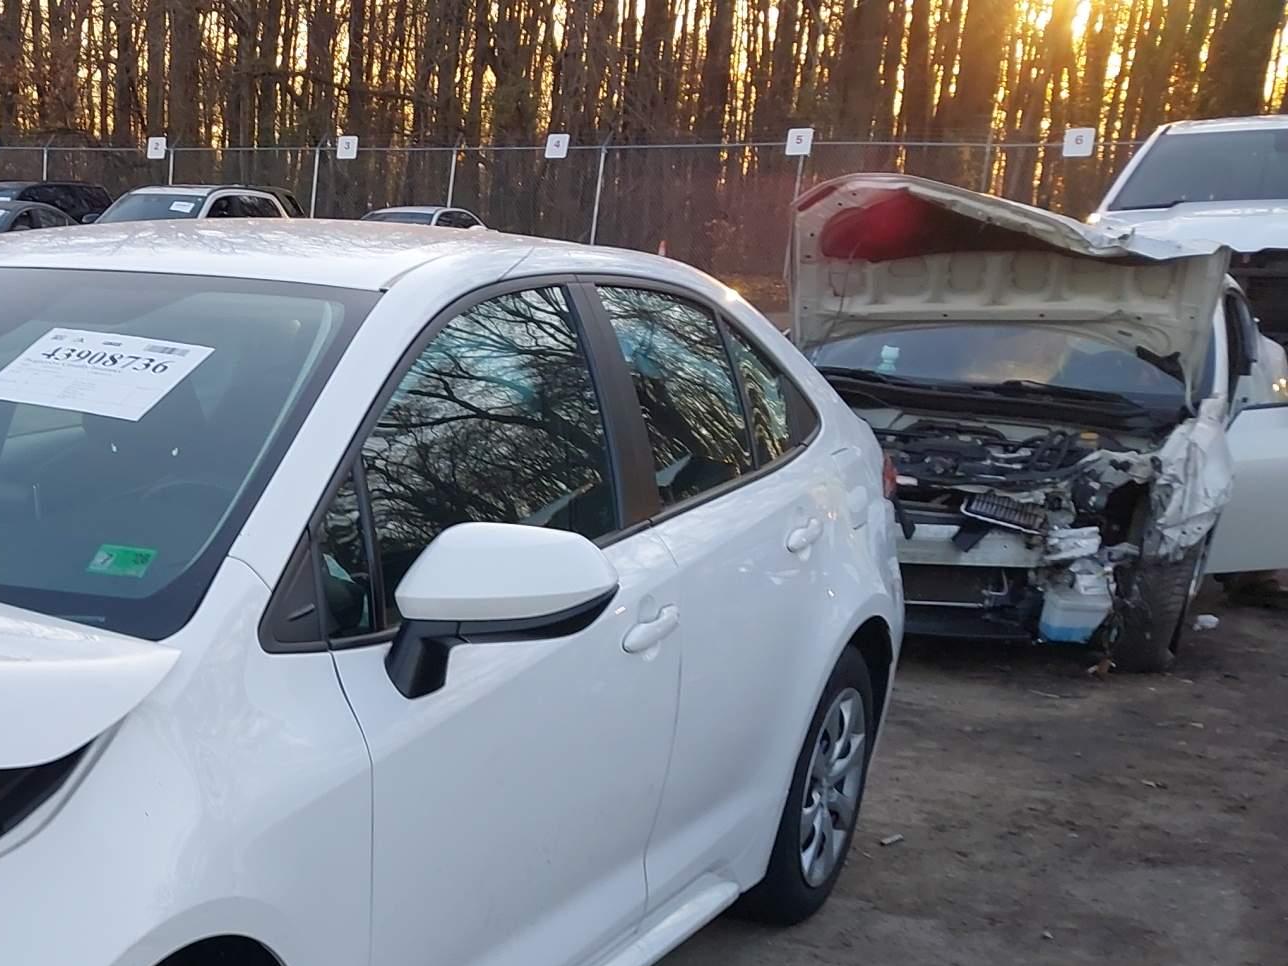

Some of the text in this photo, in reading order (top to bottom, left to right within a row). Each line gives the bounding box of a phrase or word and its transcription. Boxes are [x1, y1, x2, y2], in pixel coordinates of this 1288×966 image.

[553, 140, 561, 149] 4
[794, 135, 803, 145] 5
[1074, 135, 1084, 145] 6
[153, 141, 161, 150] 2
[343, 142, 351, 150] 3
[41, 346, 175, 374] 43908736
